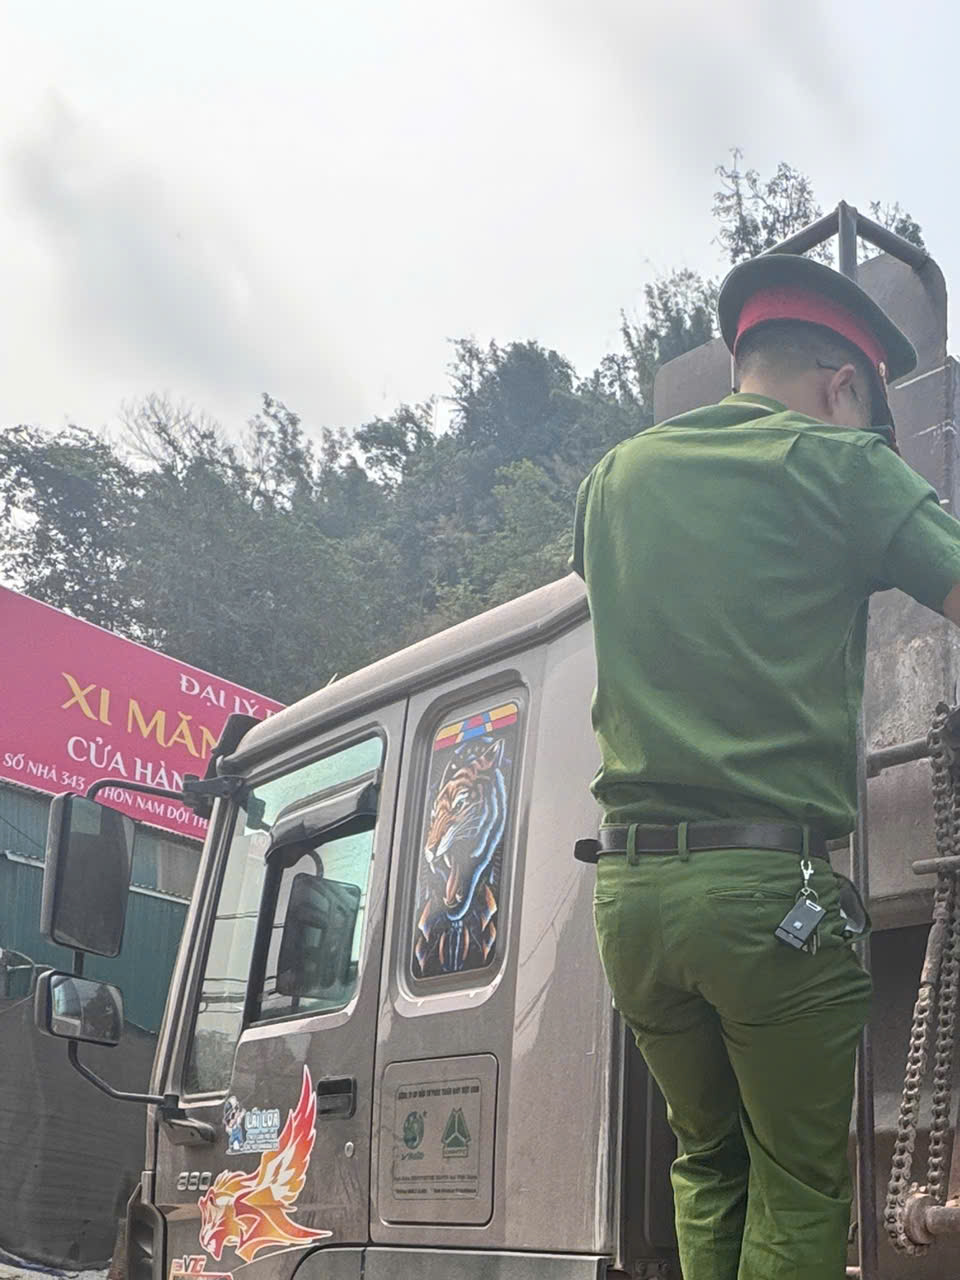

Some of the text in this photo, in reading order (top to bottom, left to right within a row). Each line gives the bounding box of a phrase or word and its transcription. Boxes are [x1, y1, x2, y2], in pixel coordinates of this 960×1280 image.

[61, 671, 112, 726] XI
[180, 673, 226, 708] ĐẠI
[67, 736, 128, 777] CỬA
[3, 752, 25, 770] SỐ
[60, 771, 86, 790] 343
[136, 795, 165, 817] NAM
